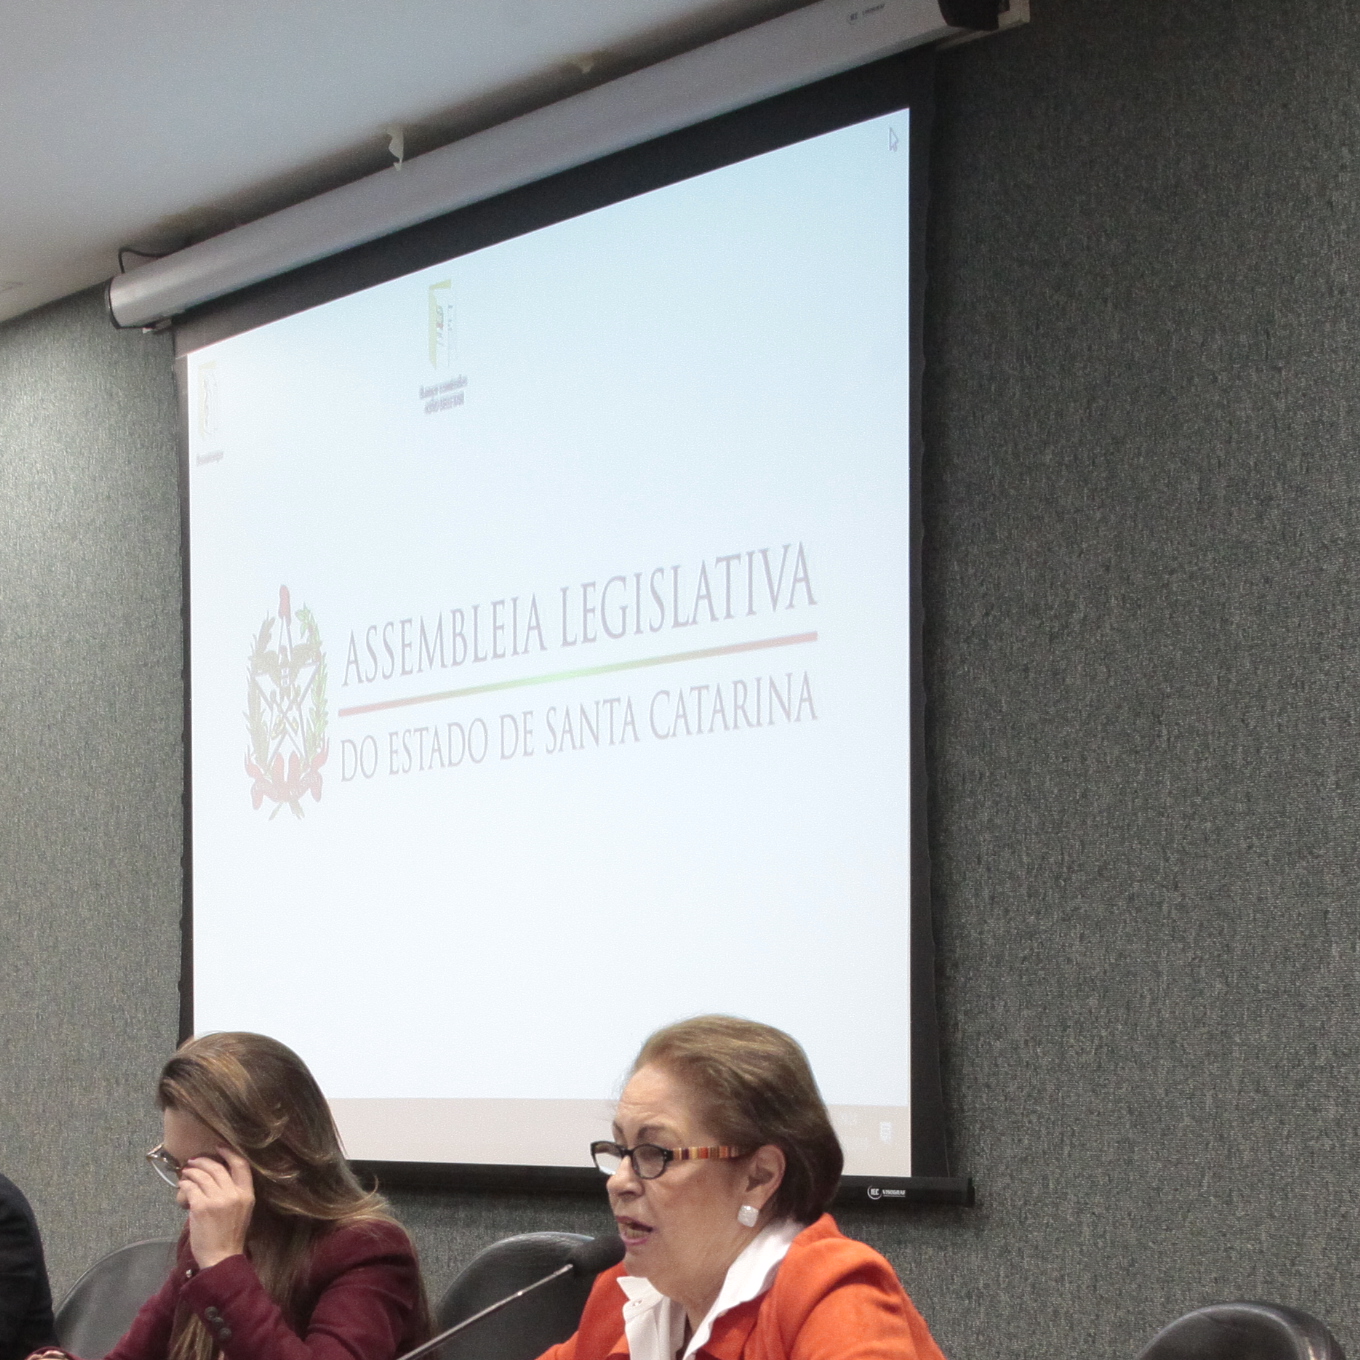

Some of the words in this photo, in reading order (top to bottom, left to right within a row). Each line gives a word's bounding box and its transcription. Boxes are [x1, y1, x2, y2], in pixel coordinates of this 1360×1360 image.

[342, 593, 547, 687] ASSEMBLEIA
[559, 541, 818, 648] LEGISLATIVA
[340, 735, 378, 782] DO
[388, 717, 489, 776] ESTADO
[500, 710, 535, 761] DE
[545, 696, 640, 755] SANTA
[649, 670, 818, 741] CATARINA
